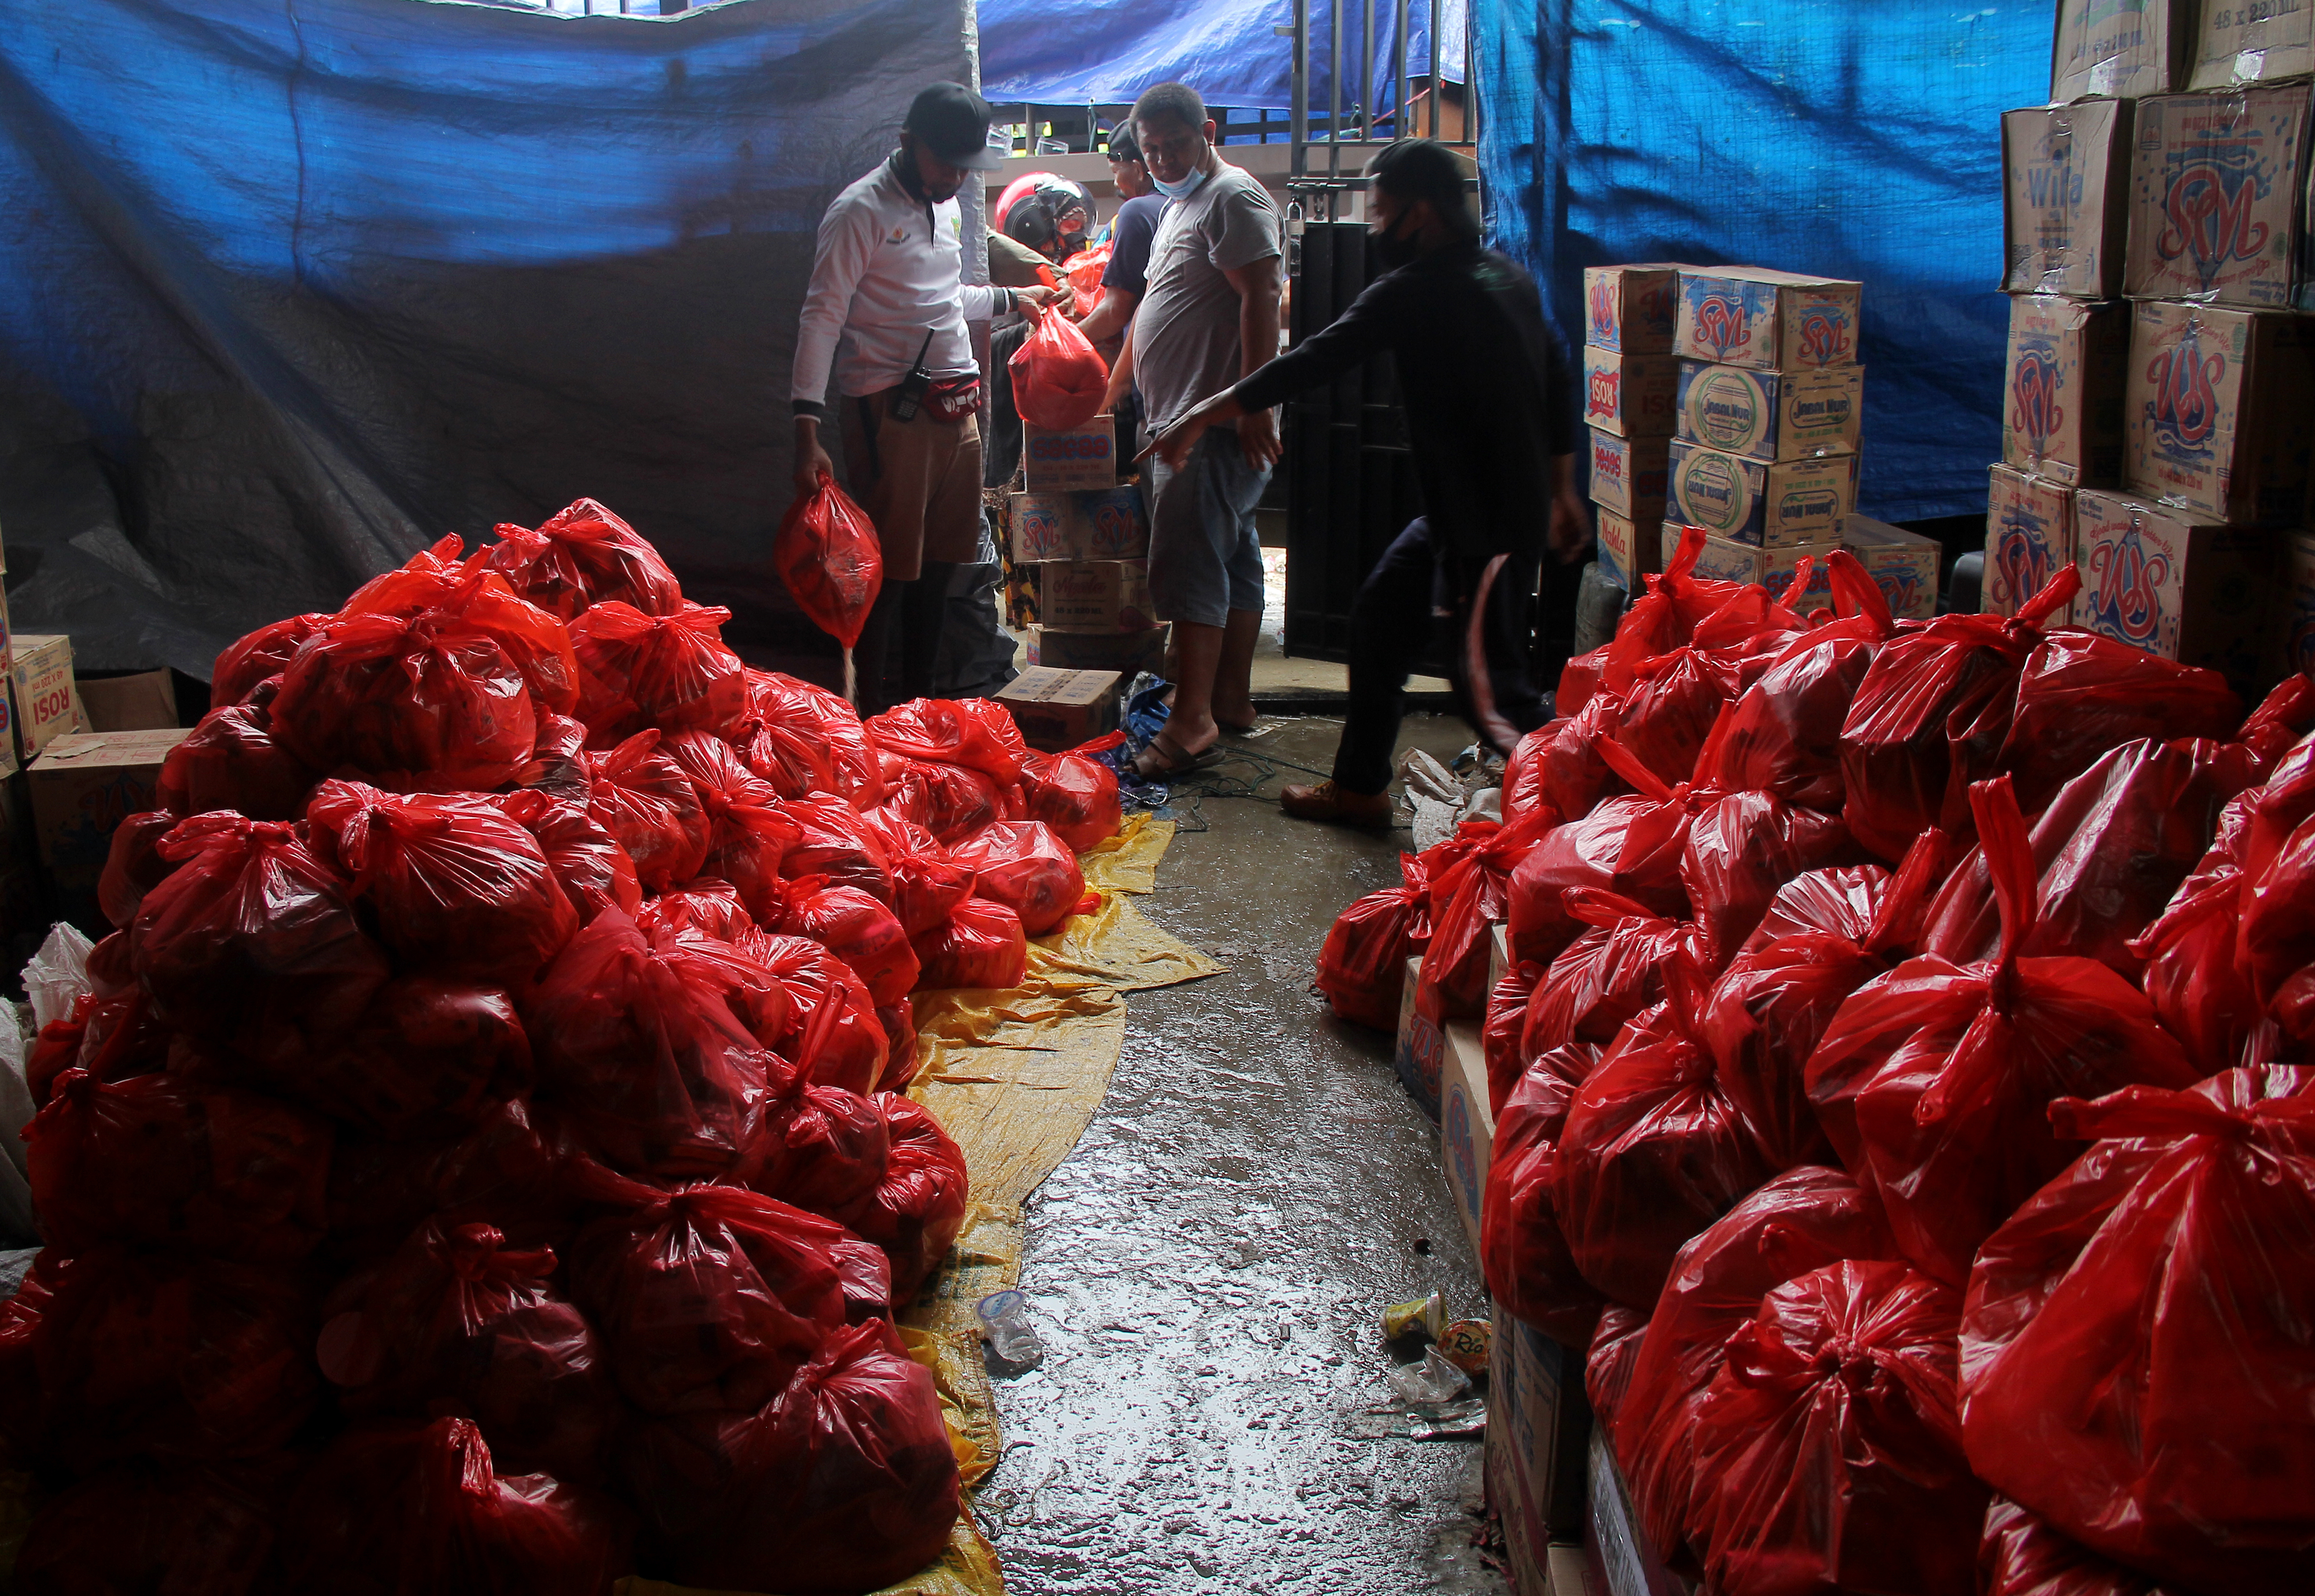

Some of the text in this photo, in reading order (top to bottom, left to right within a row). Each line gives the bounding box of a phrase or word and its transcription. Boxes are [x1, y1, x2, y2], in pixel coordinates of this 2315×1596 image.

[2214, 10, 2231, 30] 48
[33, 686, 70, 725] ROSI
[1454, 1332, 1484, 1354] Rio
